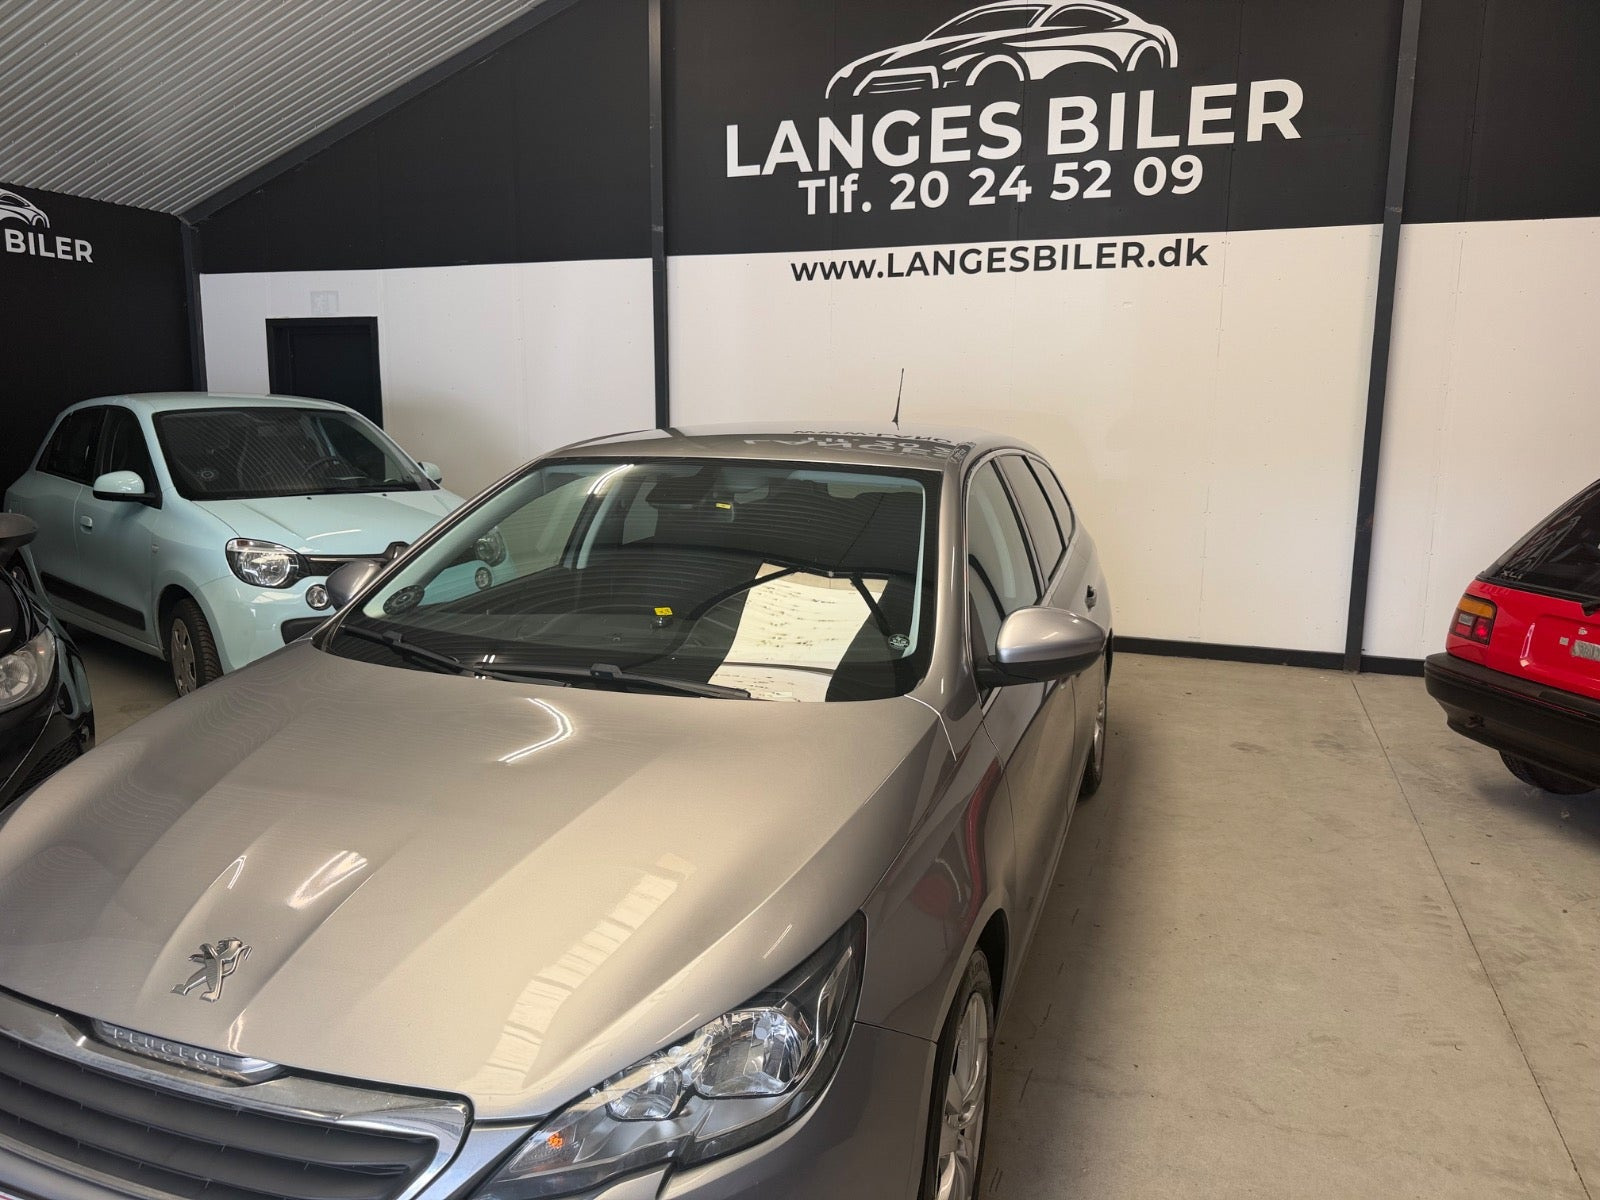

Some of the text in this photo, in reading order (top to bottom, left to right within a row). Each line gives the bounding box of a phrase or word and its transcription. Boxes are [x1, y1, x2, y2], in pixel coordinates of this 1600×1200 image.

[726, 79, 1304, 178] LANGES BILER
[798, 155, 1204, 215] Tlf. 20 24 52 09
[4, 228, 94, 263] BILER
[791, 238, 1209, 282] www.LANGESBILER.dk
[113, 1027, 224, 1067] PEUGEOT
